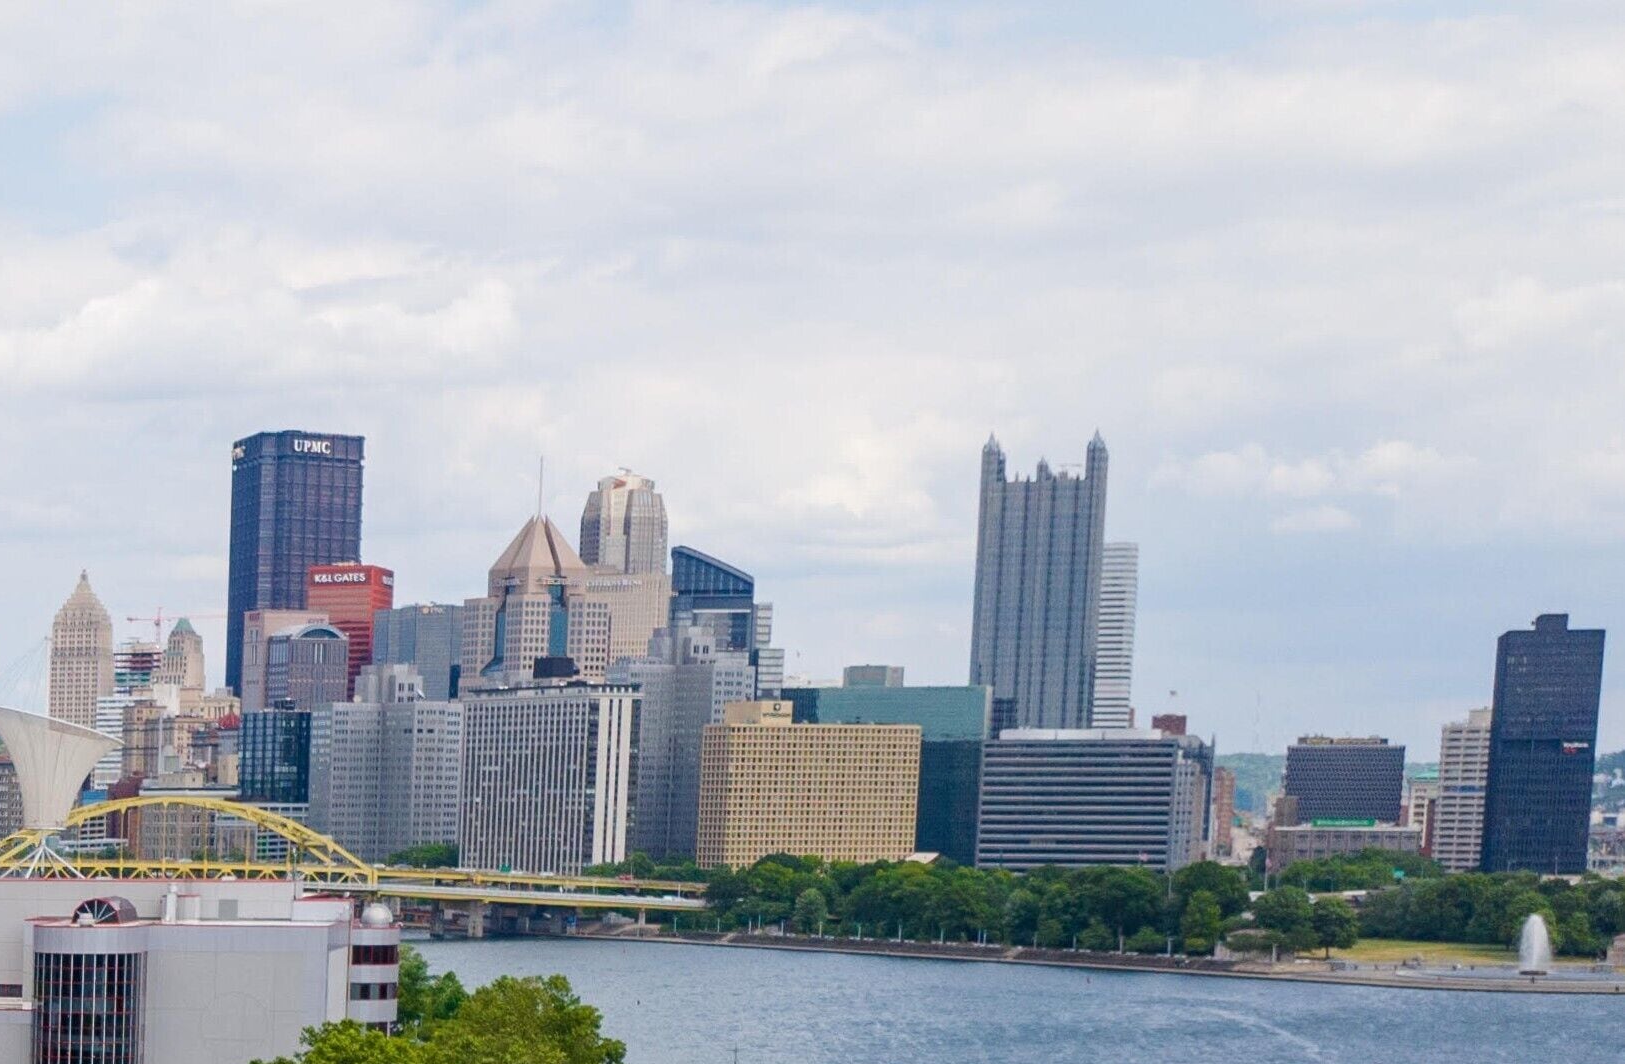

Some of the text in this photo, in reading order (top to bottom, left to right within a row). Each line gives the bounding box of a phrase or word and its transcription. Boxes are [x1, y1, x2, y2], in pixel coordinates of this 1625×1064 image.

[294, 439, 331, 455] UPMC
[314, 572, 366, 583] K&L GATES
